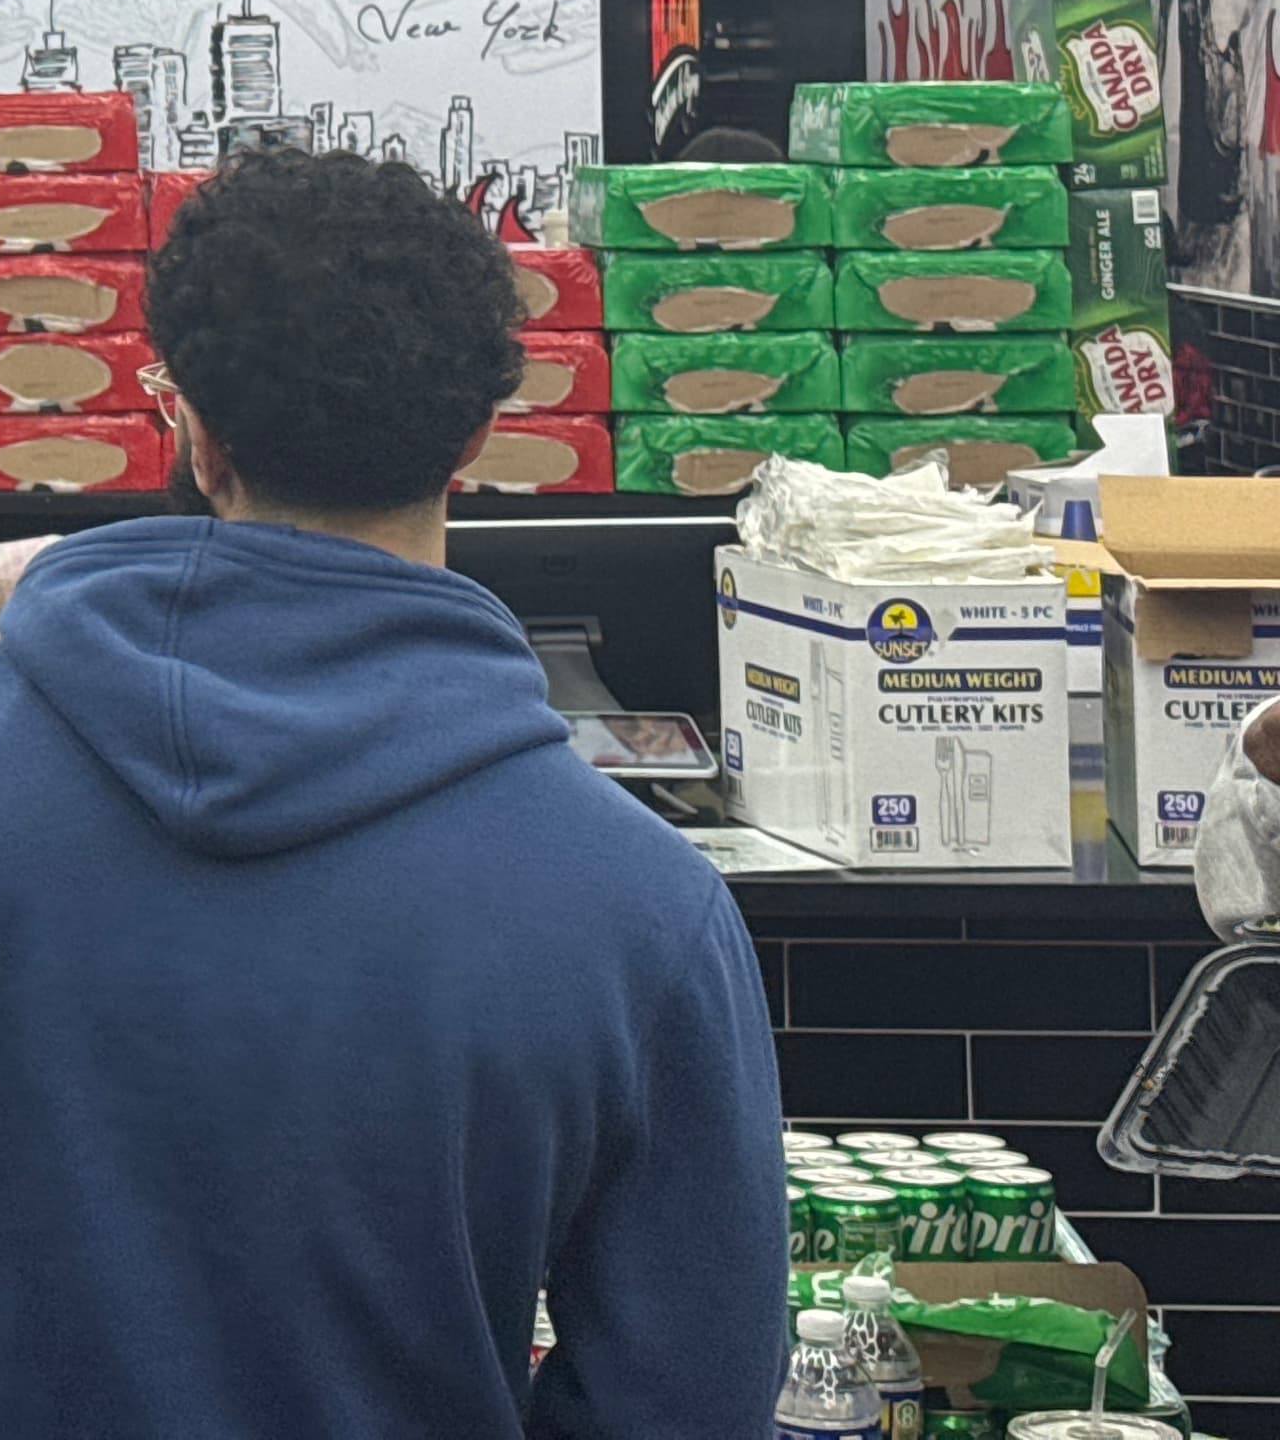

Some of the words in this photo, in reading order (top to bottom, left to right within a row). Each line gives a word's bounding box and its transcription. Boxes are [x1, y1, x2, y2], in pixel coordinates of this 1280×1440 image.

[480, 0, 566, 60] York
[1082, 20, 1140, 131] CANADA
[1115, 40, 1154, 97] DRY
[1096, 209, 1112, 236] ALE
[1099, 240, 1116, 300] GINGER
[1130, 341, 1167, 403] DRY
[959, 606, 1007, 619] WHITE
[1033, 606, 1054, 619] PC
[875, 640, 928, 659] SUNSET
[883, 672, 962, 688] MEDIUM
[966, 672, 1038, 688] WEIGHT
[1168, 669, 1253, 686] MEDIUM
[878, 703, 985, 724] CUTLERY
[993, 703, 1044, 723] KITS
[877, 798, 910, 817] 250
[1163, 794, 1199, 812] 250
